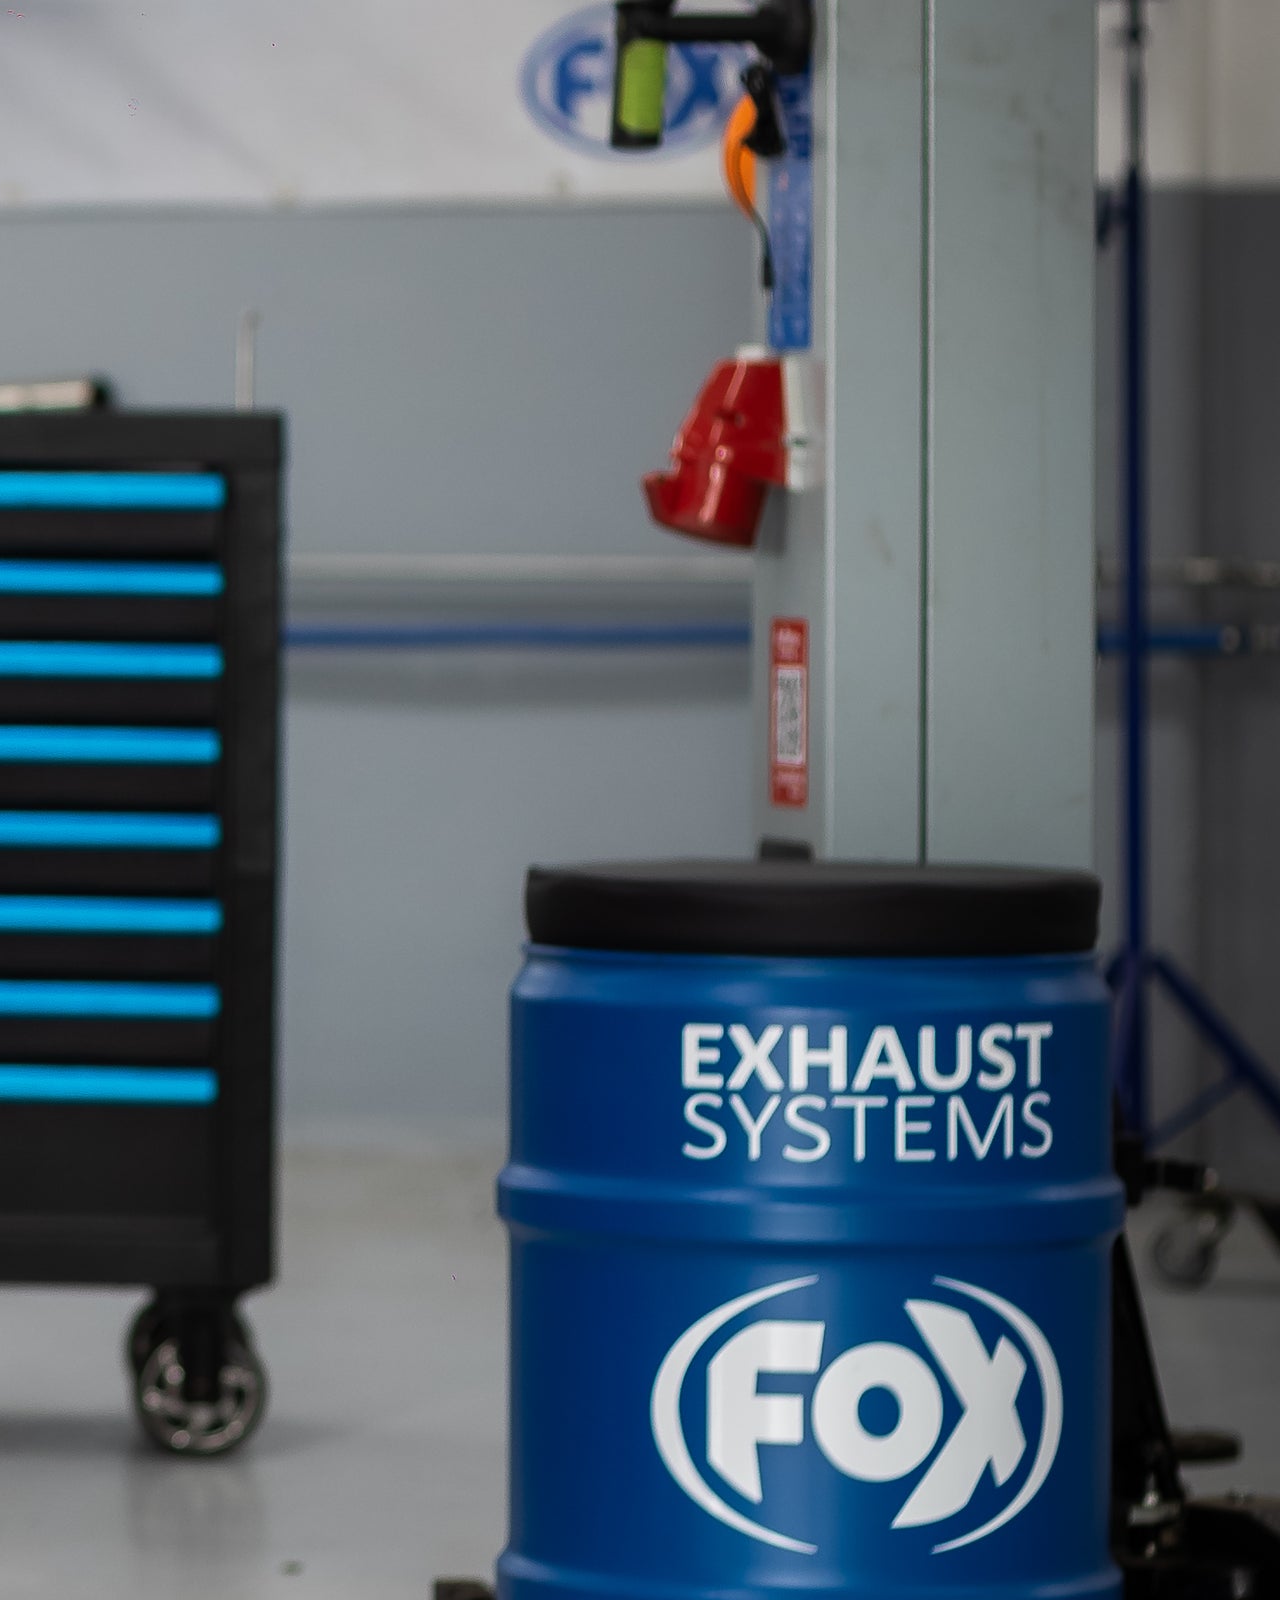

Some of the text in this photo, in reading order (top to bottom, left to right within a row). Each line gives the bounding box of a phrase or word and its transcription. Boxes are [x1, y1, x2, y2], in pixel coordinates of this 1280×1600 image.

[681, 1021, 1054, 1093] EXHAUST
[682, 1091, 1054, 1163] SYSTEMS
[706, 1298, 1028, 1529] FOX
